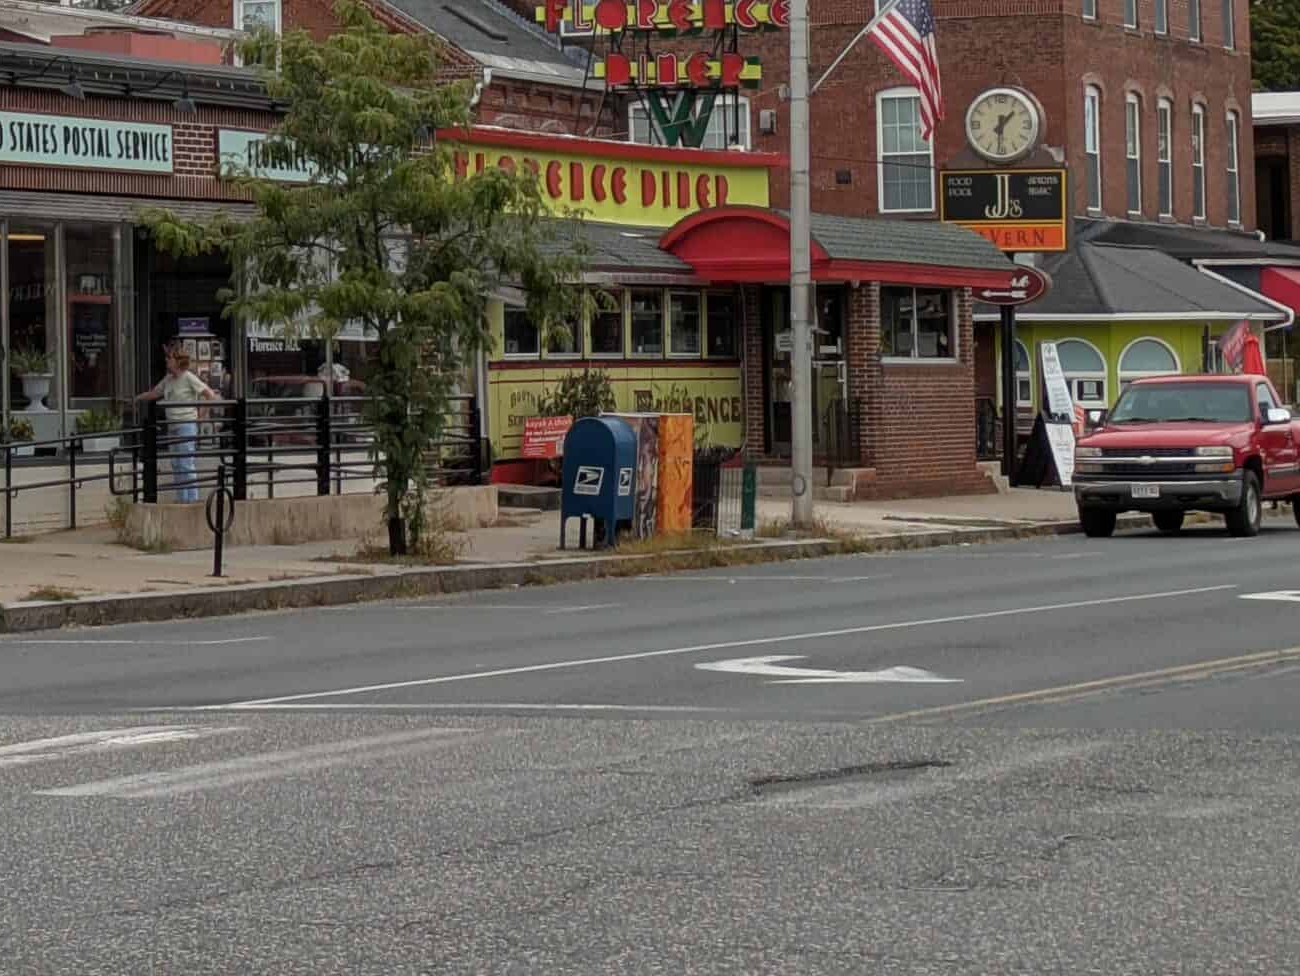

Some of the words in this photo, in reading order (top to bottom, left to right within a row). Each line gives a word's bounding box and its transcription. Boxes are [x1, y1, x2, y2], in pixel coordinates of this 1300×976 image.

[606, 52, 743, 87] DINER
[10, 121, 58, 154] STATES
[63, 126, 112, 158] POSTAL
[117, 129, 169, 162] SERVICE
[980, 229, 1045, 246] VERN
